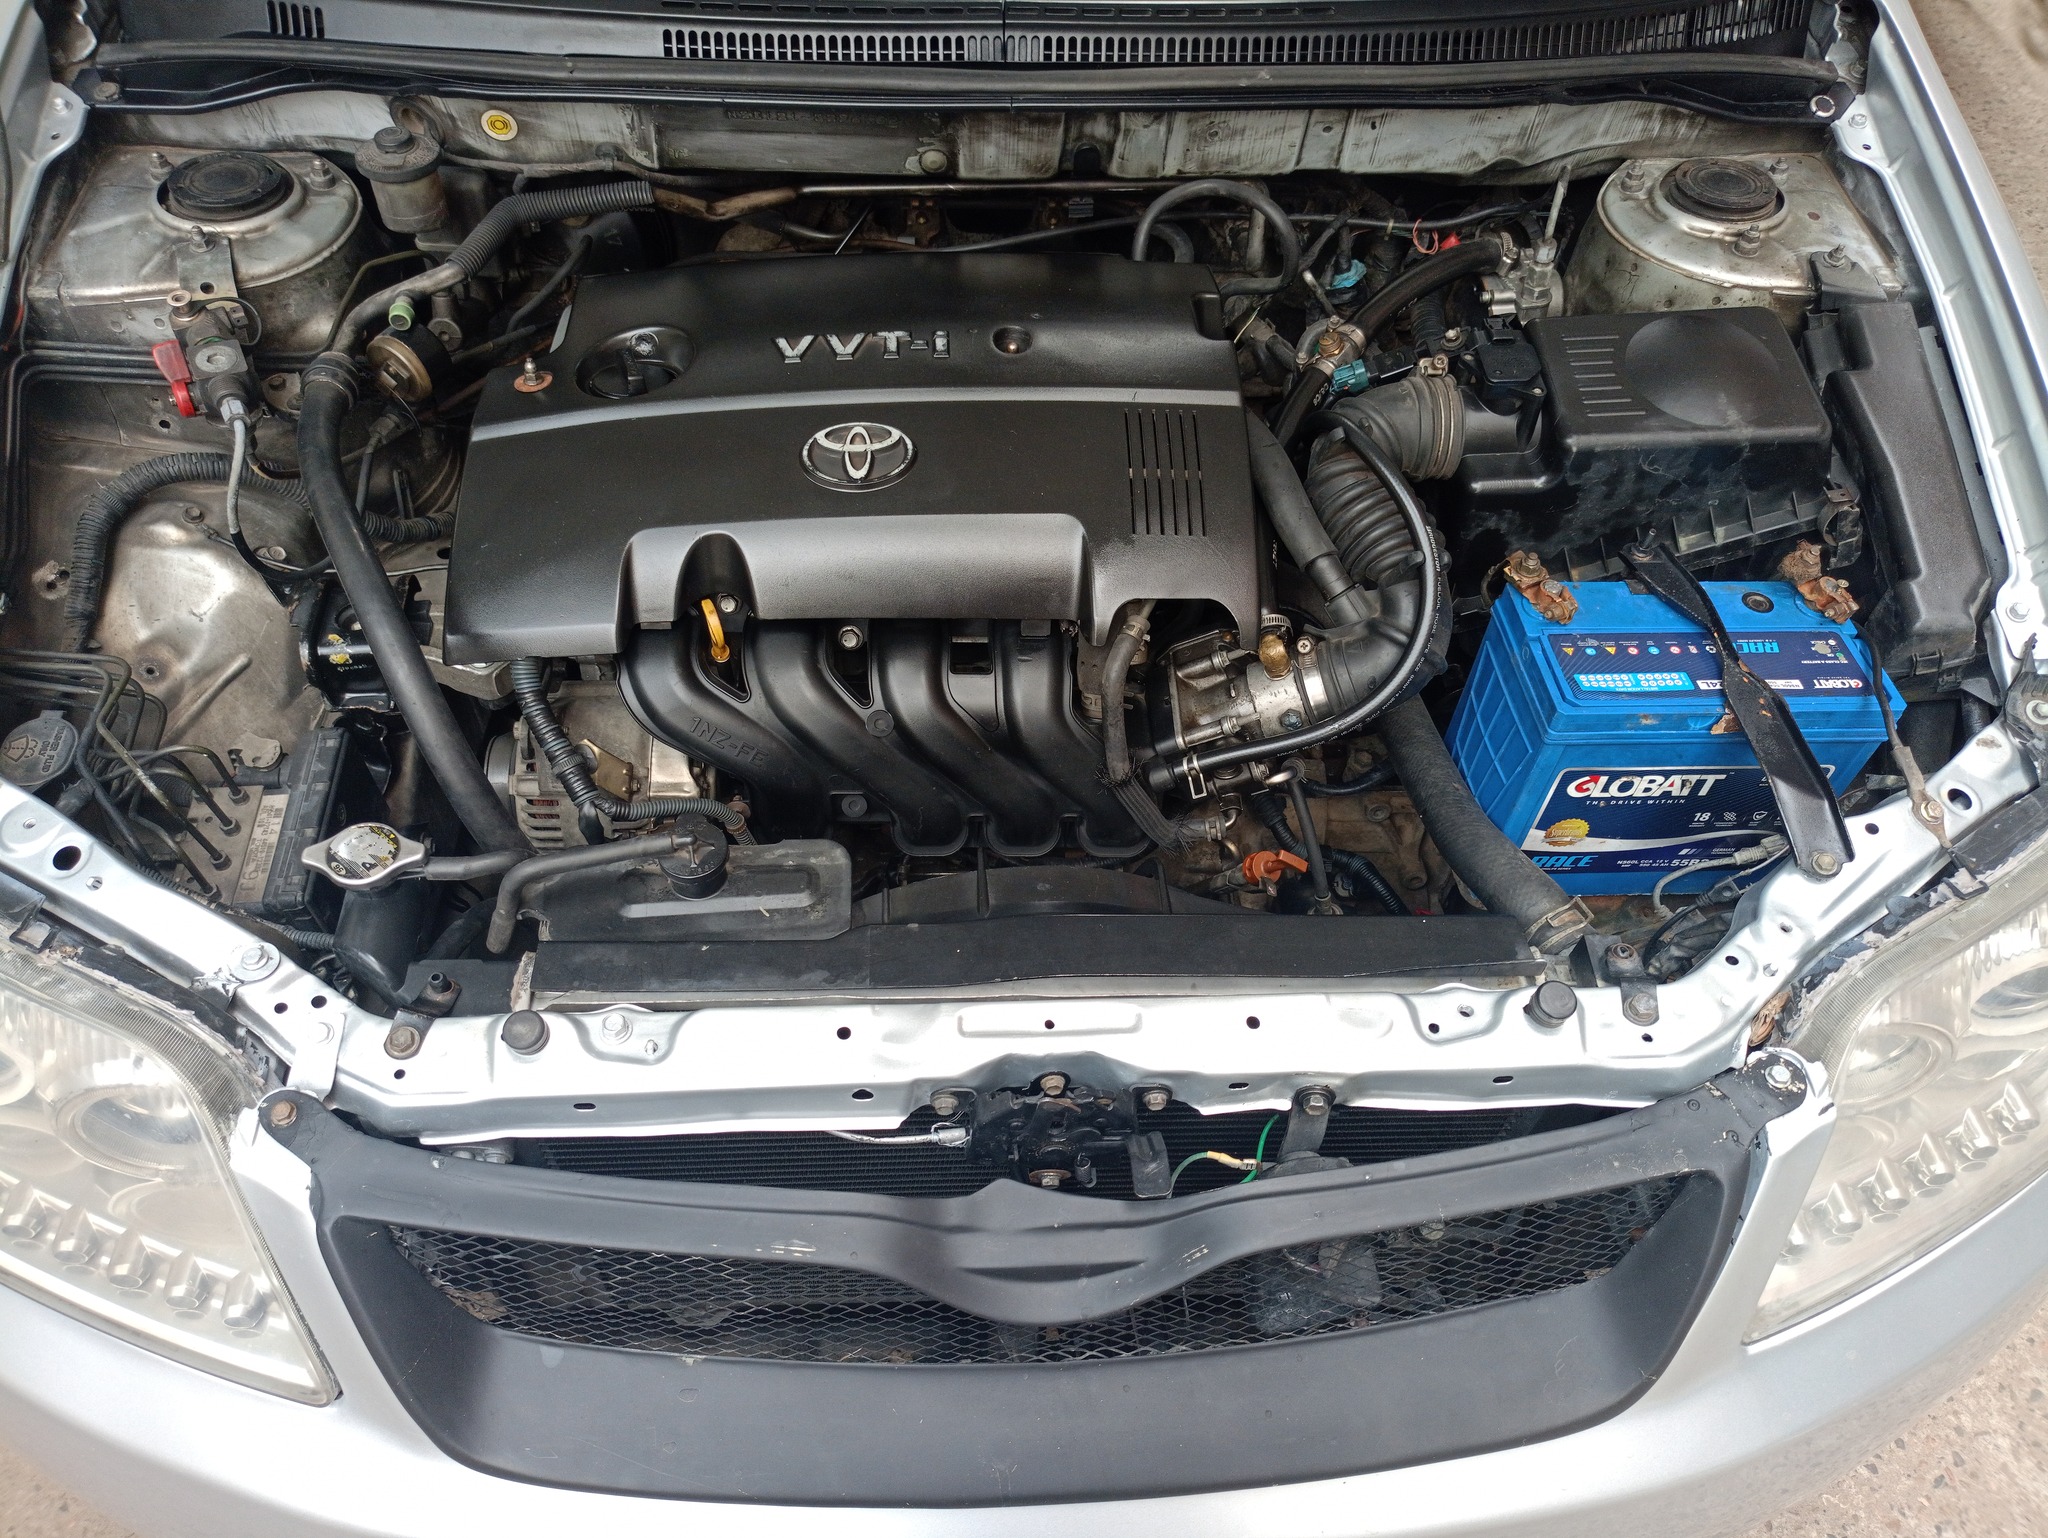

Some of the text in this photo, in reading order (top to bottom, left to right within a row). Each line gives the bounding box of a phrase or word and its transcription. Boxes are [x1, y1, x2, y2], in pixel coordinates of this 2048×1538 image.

[772, 330, 950, 364] VVT-i
[1733, 642, 1780, 654] RAC
[1813, 679, 1863, 689] GLOBATT
[690, 717, 769, 768] 1NZ-FE
[1566, 775, 1727, 798] GLOBATT
[1693, 812, 1712, 821] 18
